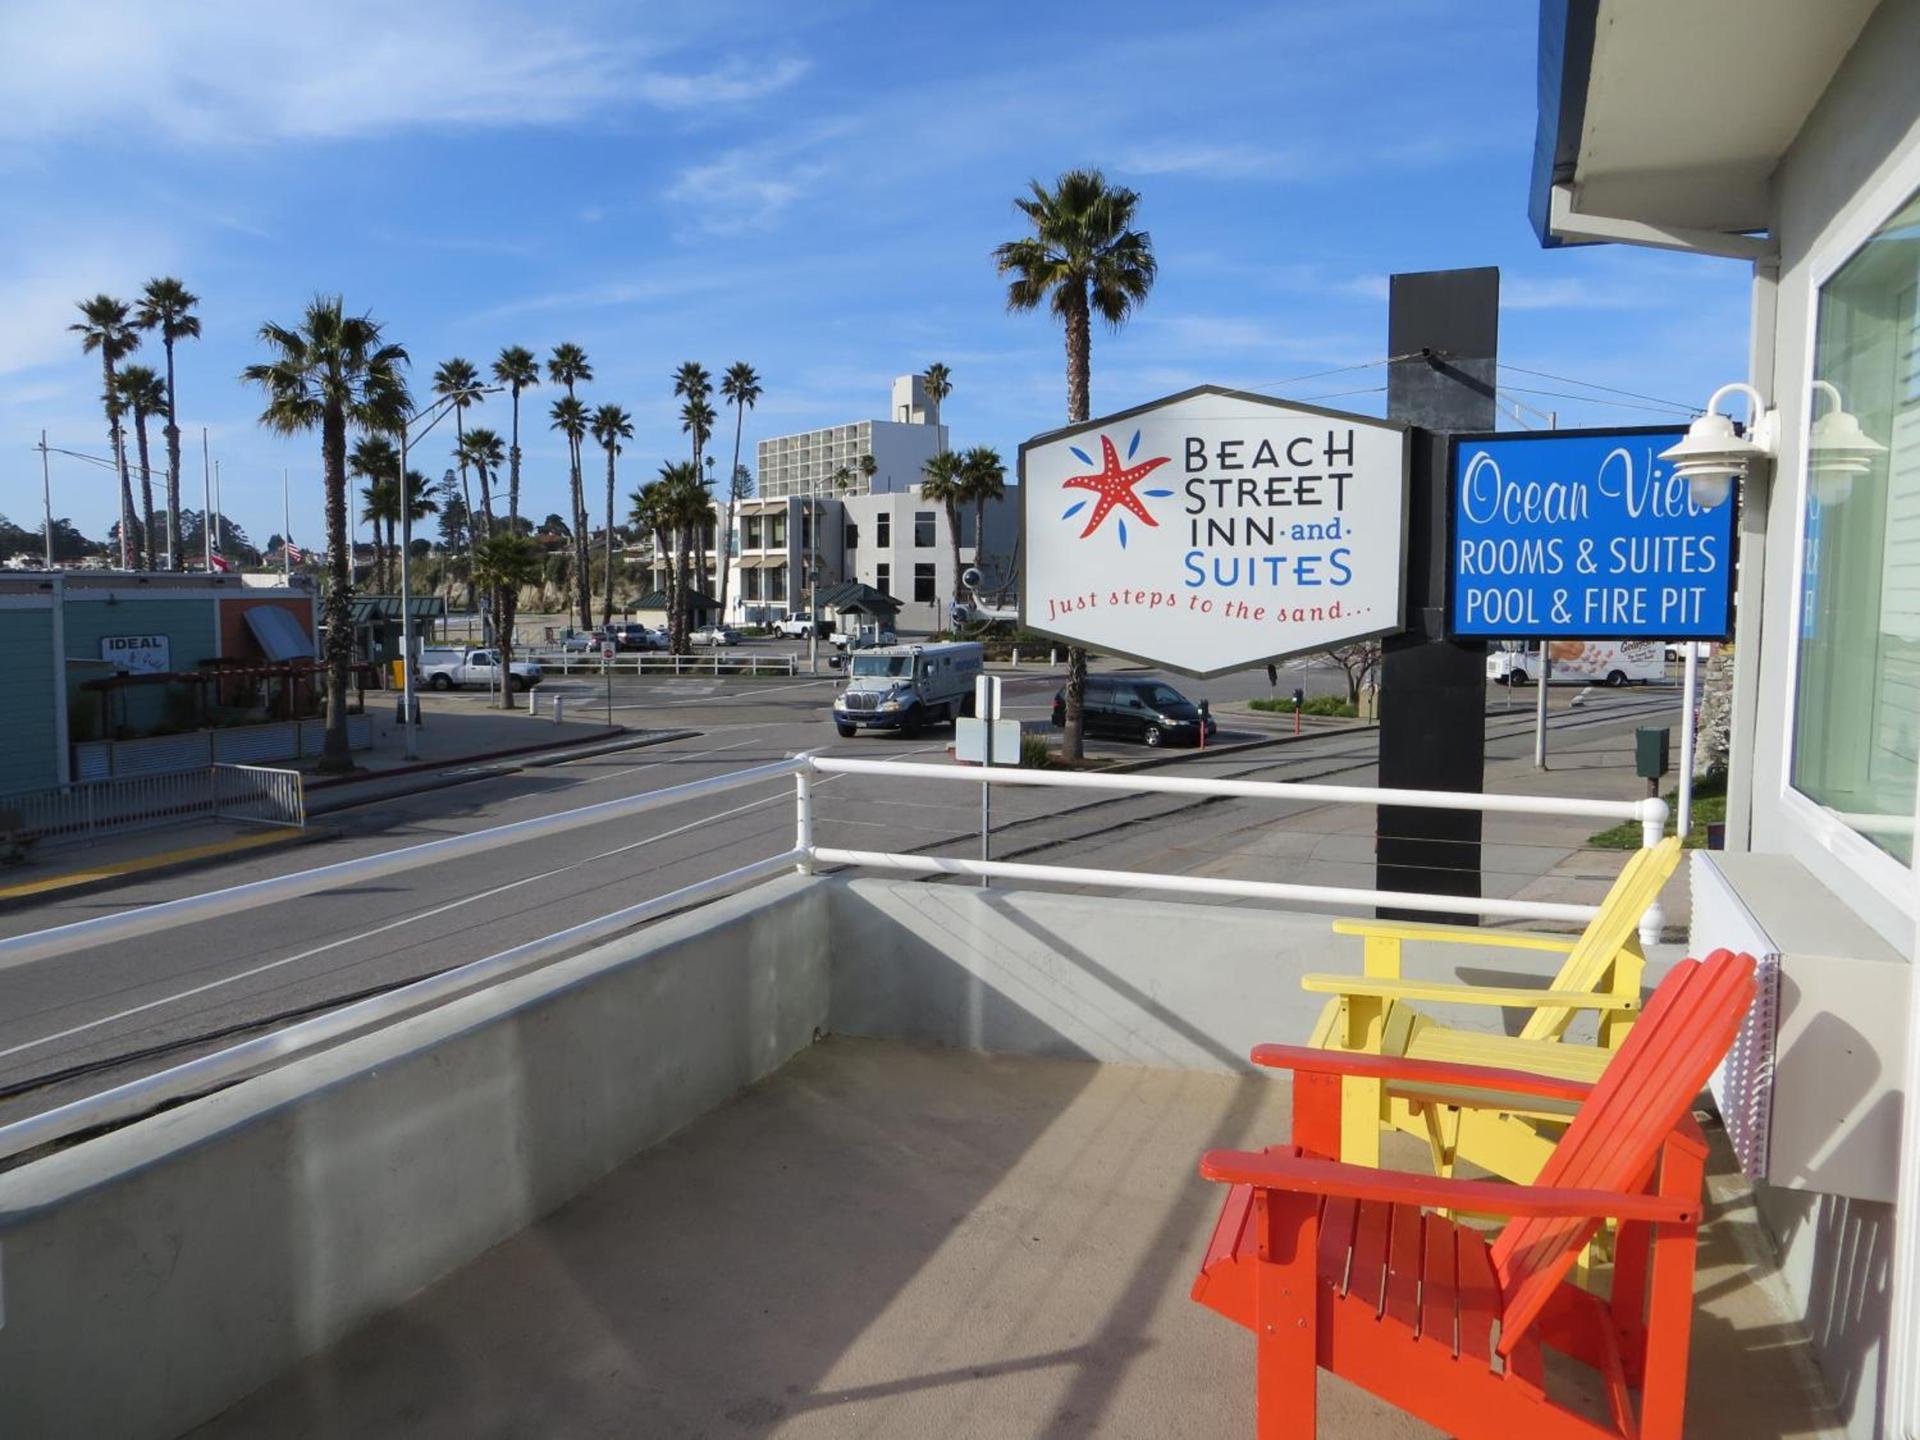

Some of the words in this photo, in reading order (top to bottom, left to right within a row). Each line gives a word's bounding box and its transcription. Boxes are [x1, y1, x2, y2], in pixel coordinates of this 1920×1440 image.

[1185, 430, 1354, 473] BEACH
[1185, 473, 1354, 515] STREET
[1462, 450, 1588, 525] Ocean
[1191, 517, 1274, 547] INN
[1185, 548, 1353, 588] SUITES
[1460, 539, 1564, 575] ROOMS
[1576, 538, 1598, 574] &
[1609, 536, 1716, 574] SUITES
[1048, 592, 1097, 620] Just
[1109, 588, 1176, 609] steps
[1189, 595, 1213, 613] to
[1225, 601, 1265, 620] the
[1467, 588, 1539, 624] POOL
[1550, 588, 1572, 624] &
[1584, 588, 1647, 624] FIRE
[1661, 587, 1706, 624] PIT
[109, 637, 162, 650] IDEAL
